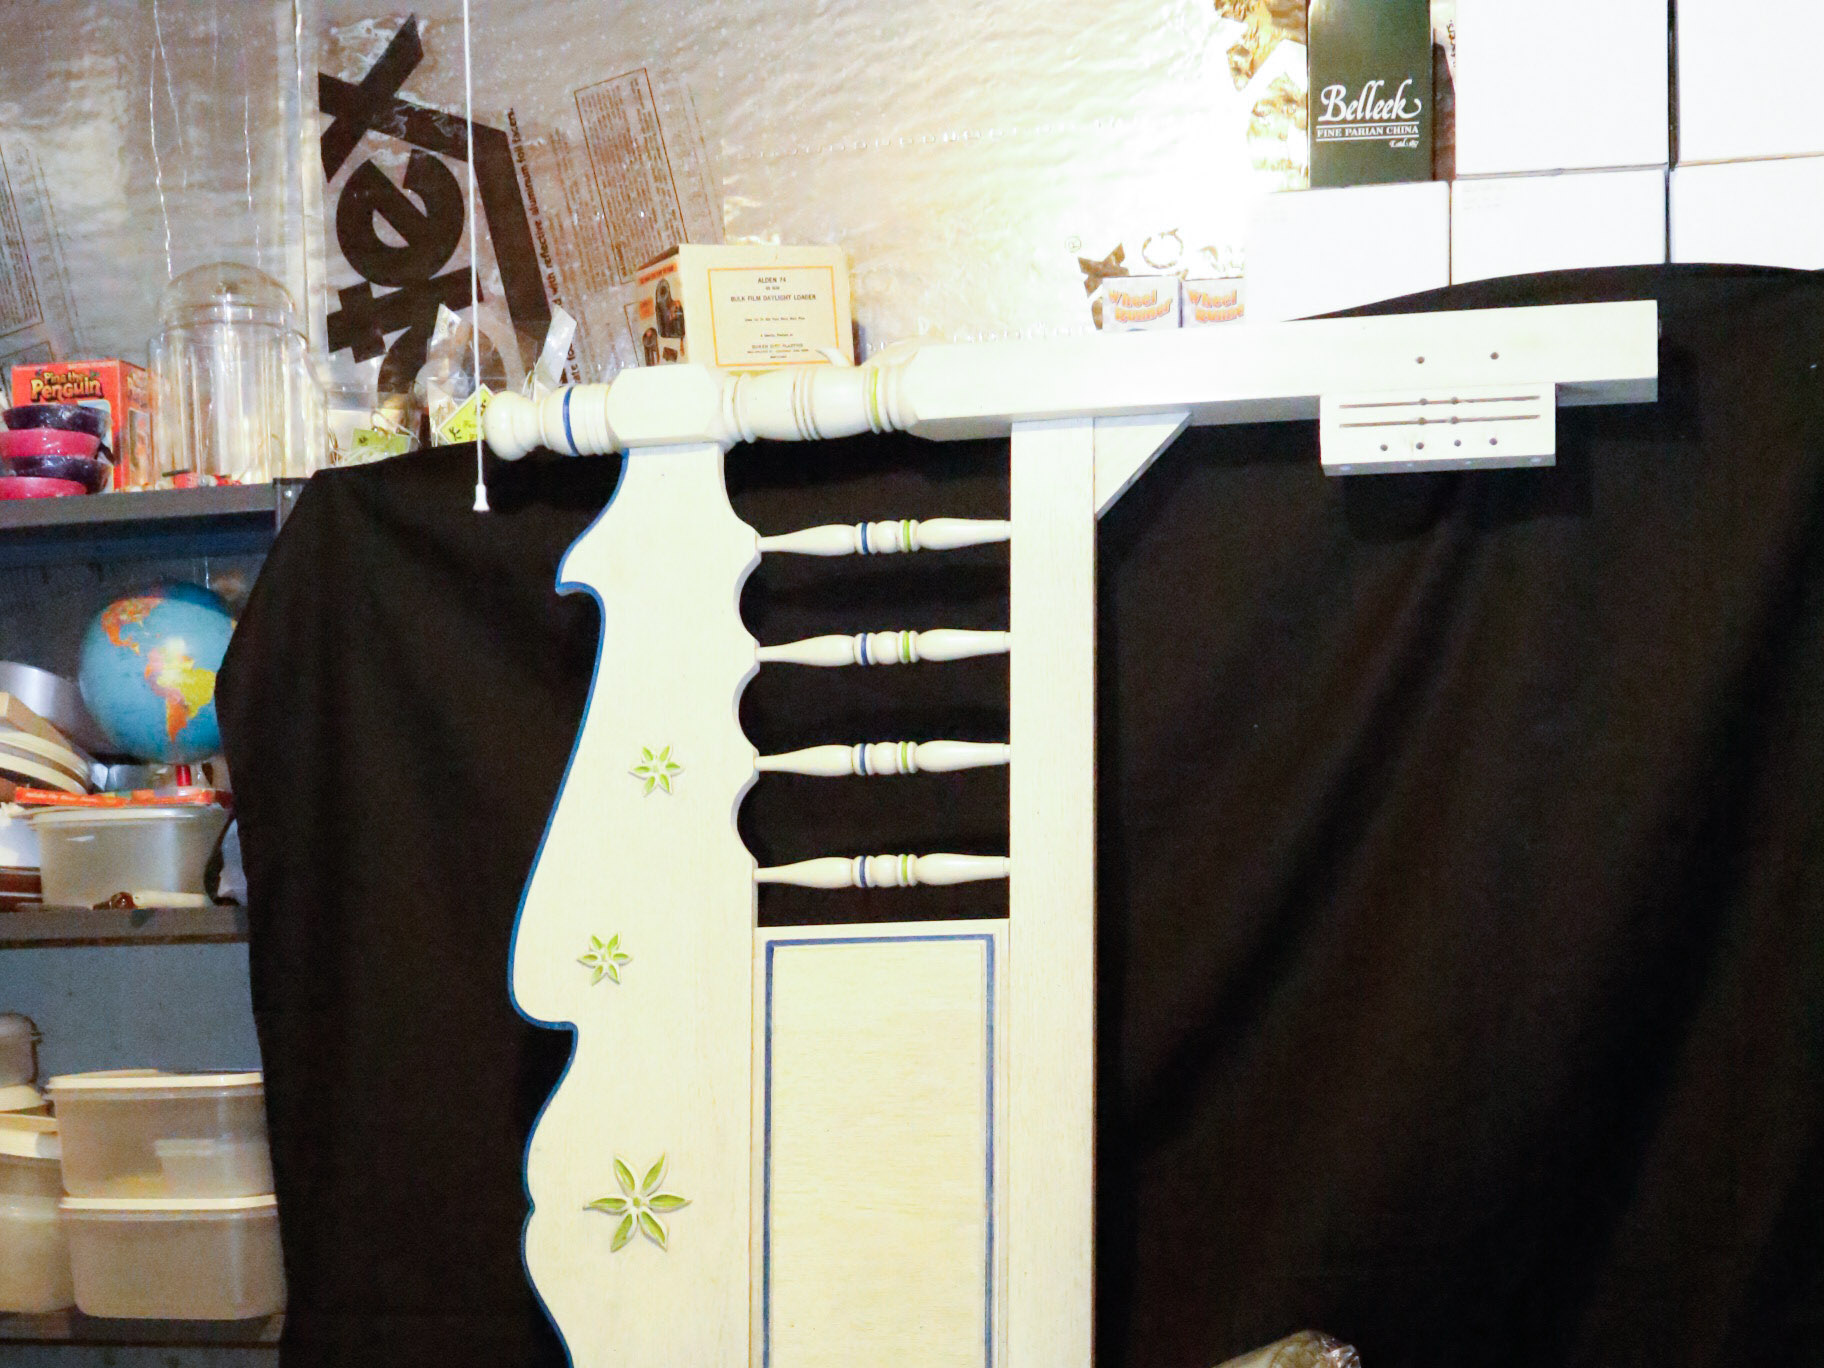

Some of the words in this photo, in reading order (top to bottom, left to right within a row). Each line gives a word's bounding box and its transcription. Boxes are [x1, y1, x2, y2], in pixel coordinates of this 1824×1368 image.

[1318, 79, 1422, 122] Belleek
[1317, 127, 1342, 137] FINE
[1345, 126, 1384, 137] PARIAN
[1386, 125, 1419, 135] CHINA
[515, 144, 527, 164] foil
[520, 164, 540, 215] aluminum
[534, 219, 553, 269] reflective
[546, 272, 558, 296] with
[793, 293, 816, 301] LOADER
[1107, 289, 1157, 308] Wheel
[1187, 289, 1237, 309] Wheel
[1115, 298, 1174, 323] Runner
[1195, 303, 1245, 323] Runne
[30, 376, 104, 402] Penguin
